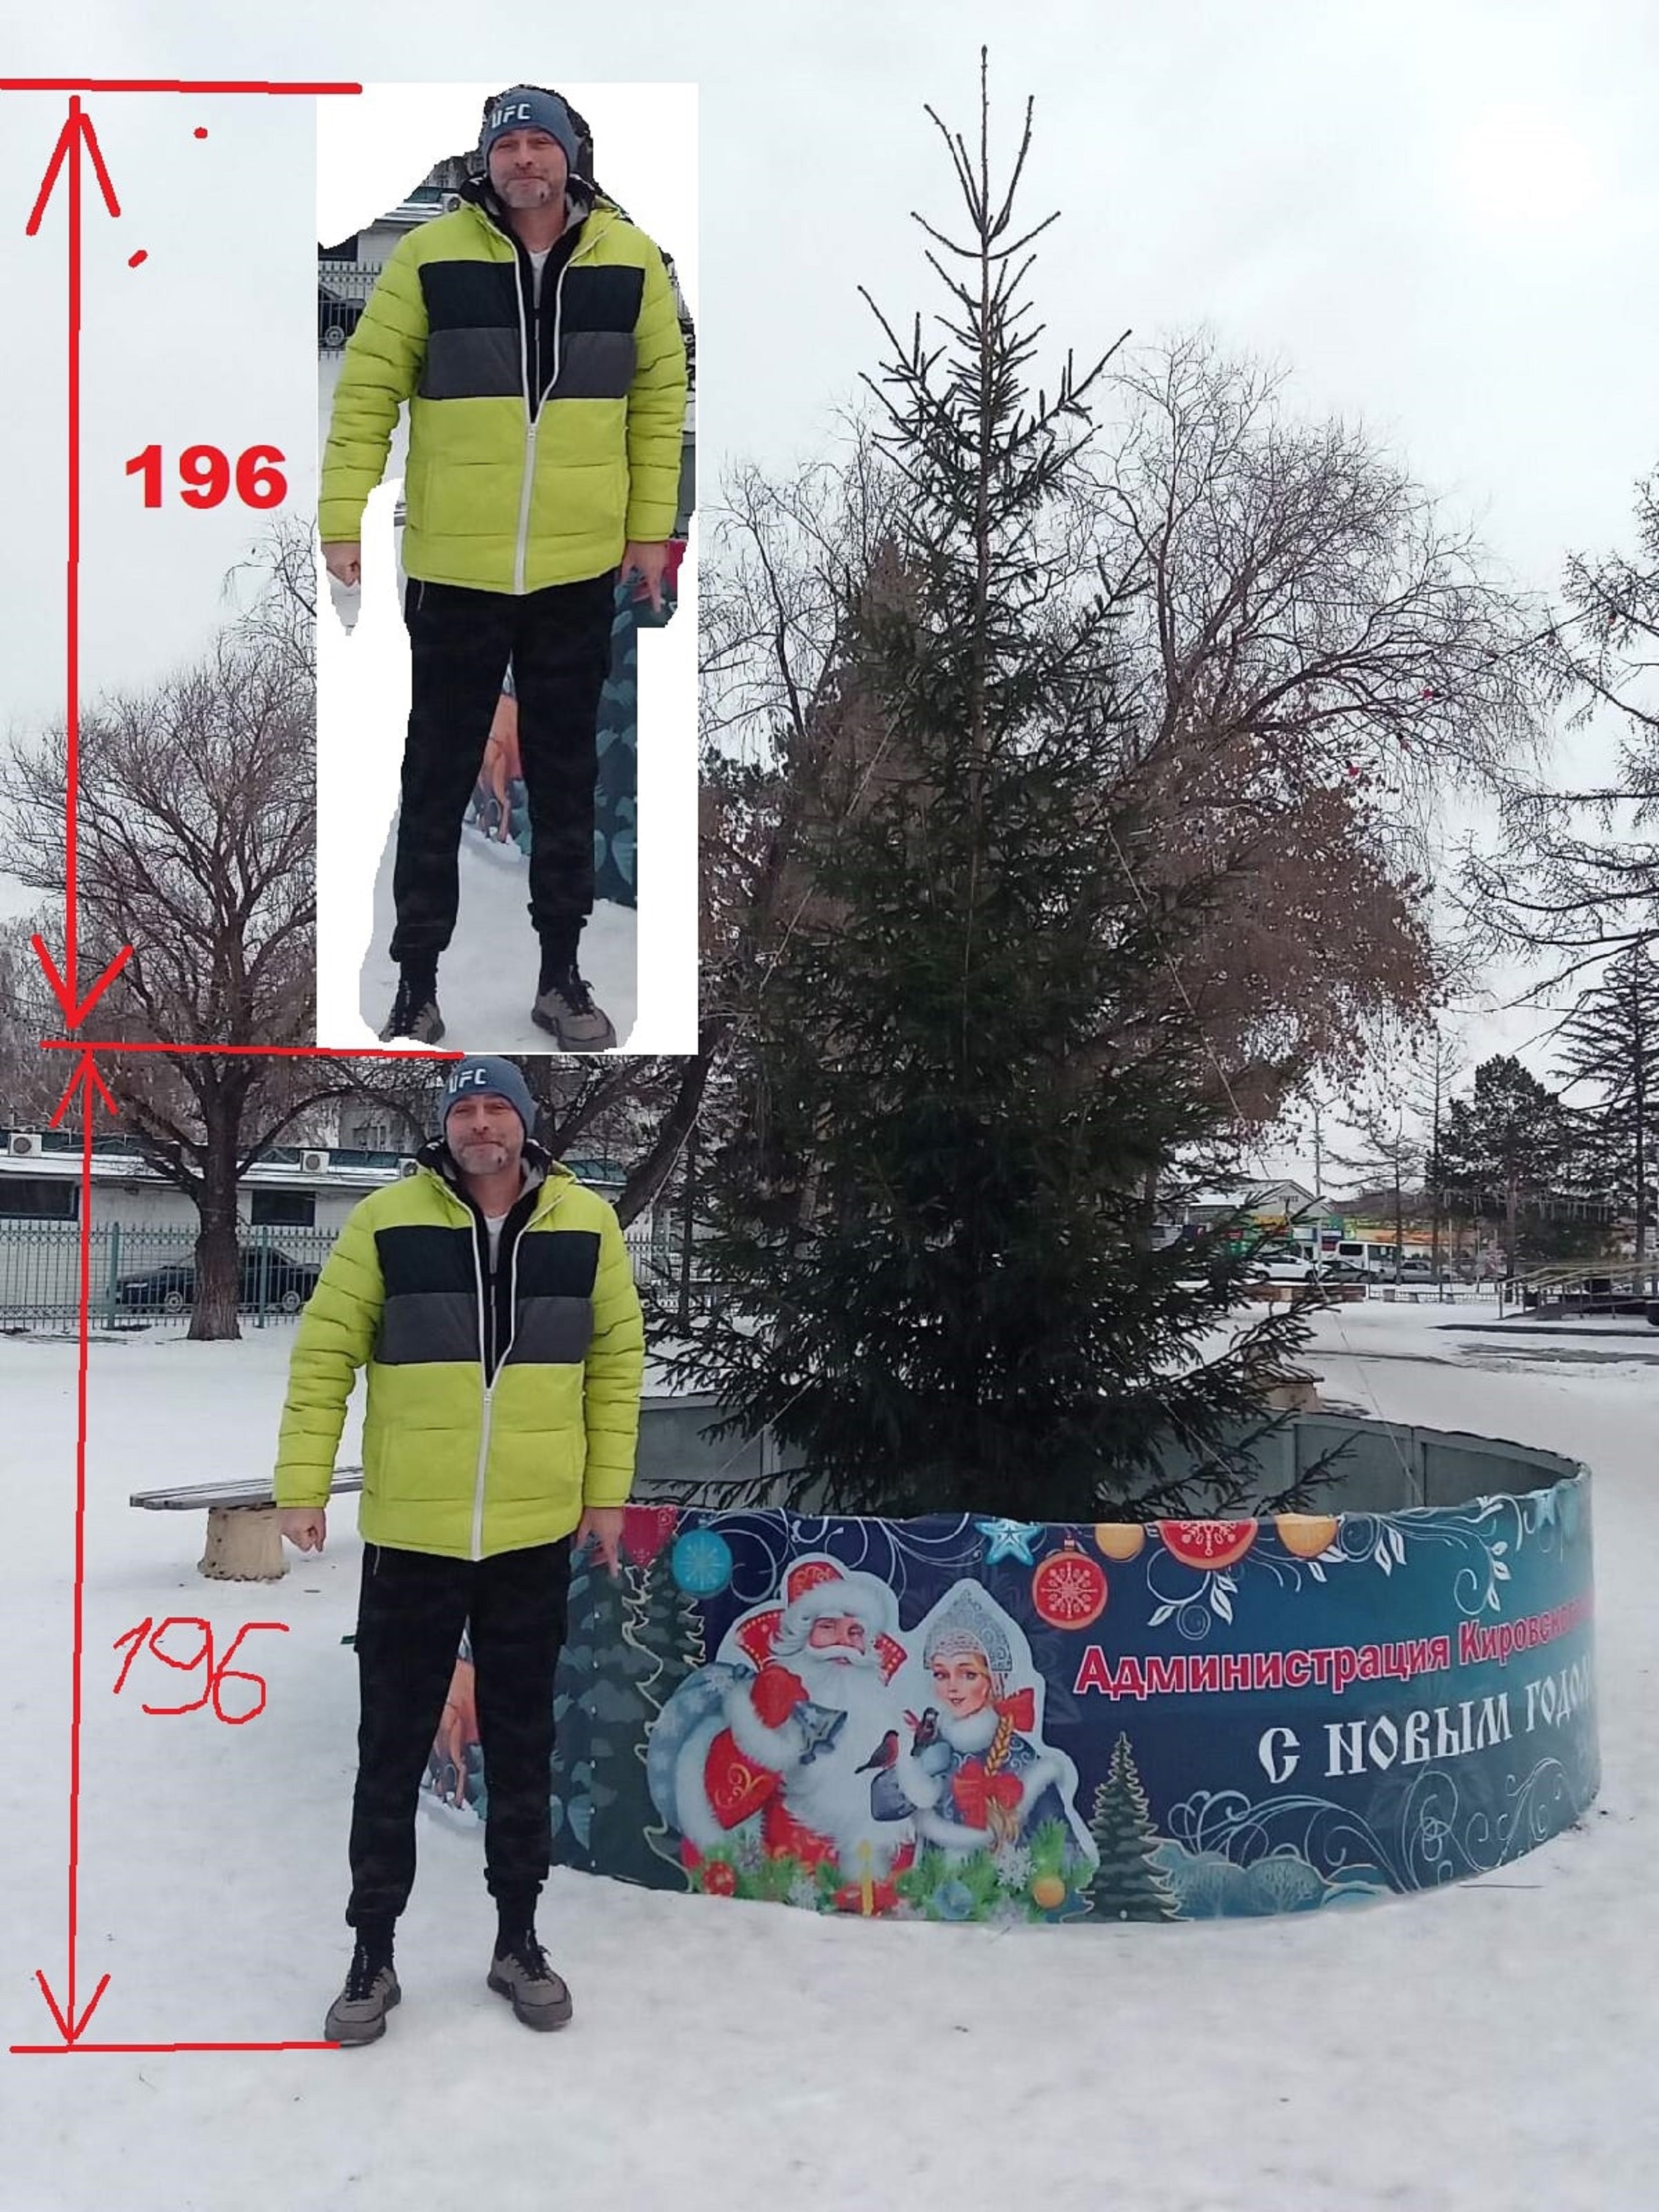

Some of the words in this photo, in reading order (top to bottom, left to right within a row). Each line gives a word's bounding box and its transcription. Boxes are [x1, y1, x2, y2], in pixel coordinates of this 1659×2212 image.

[491, 103, 531, 129] UFC
[449, 1069, 487, 1093] UFC
[1073, 1635, 1450, 1700] Администрация
